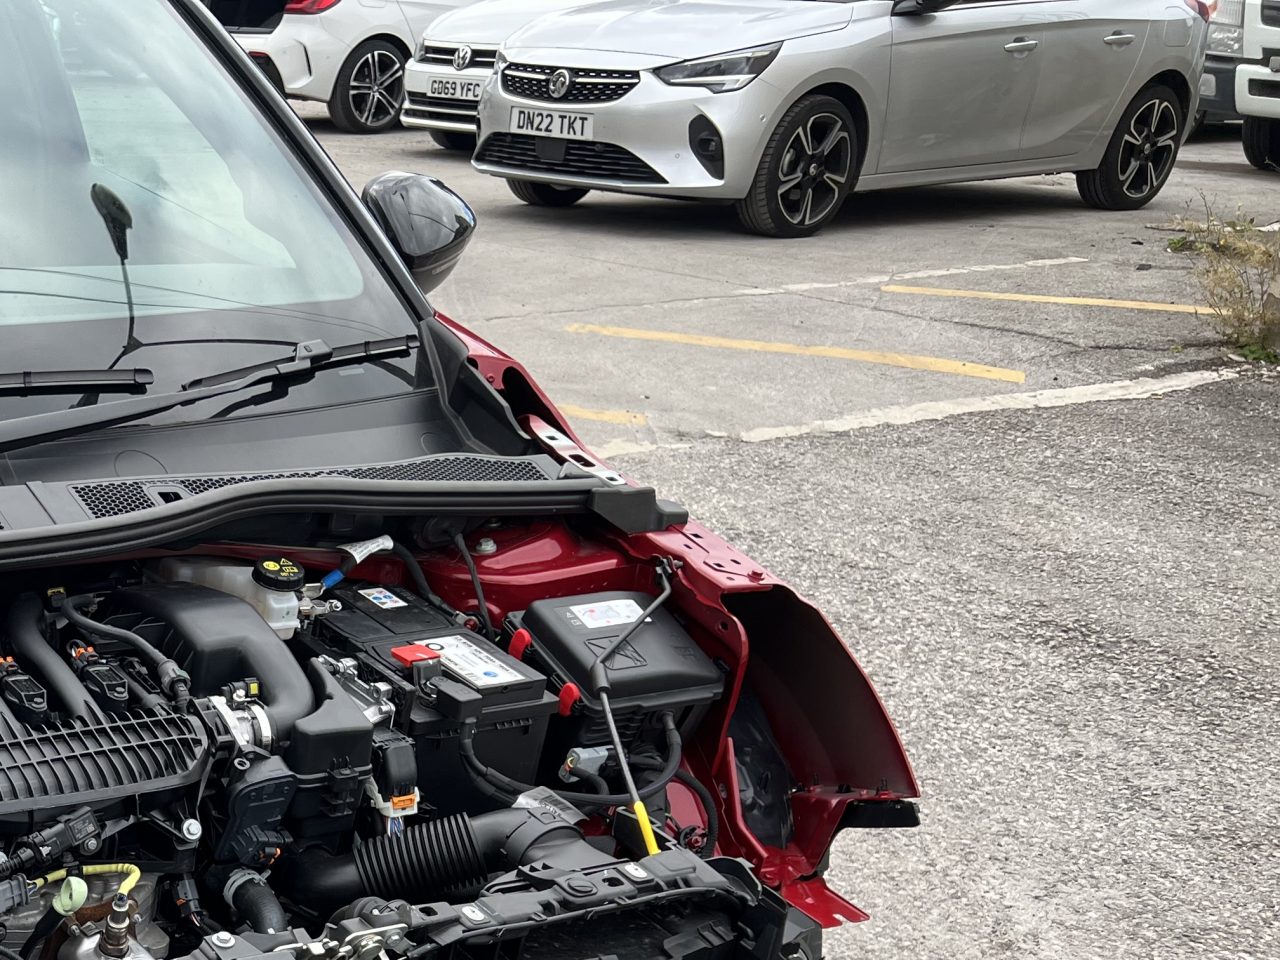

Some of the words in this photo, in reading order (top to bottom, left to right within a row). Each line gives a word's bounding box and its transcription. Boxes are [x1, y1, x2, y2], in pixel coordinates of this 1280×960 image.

[430, 79, 457, 97] GD69
[459, 82, 481, 99] YFC
[516, 110, 554, 133] DN22
[558, 114, 589, 137] TKT
